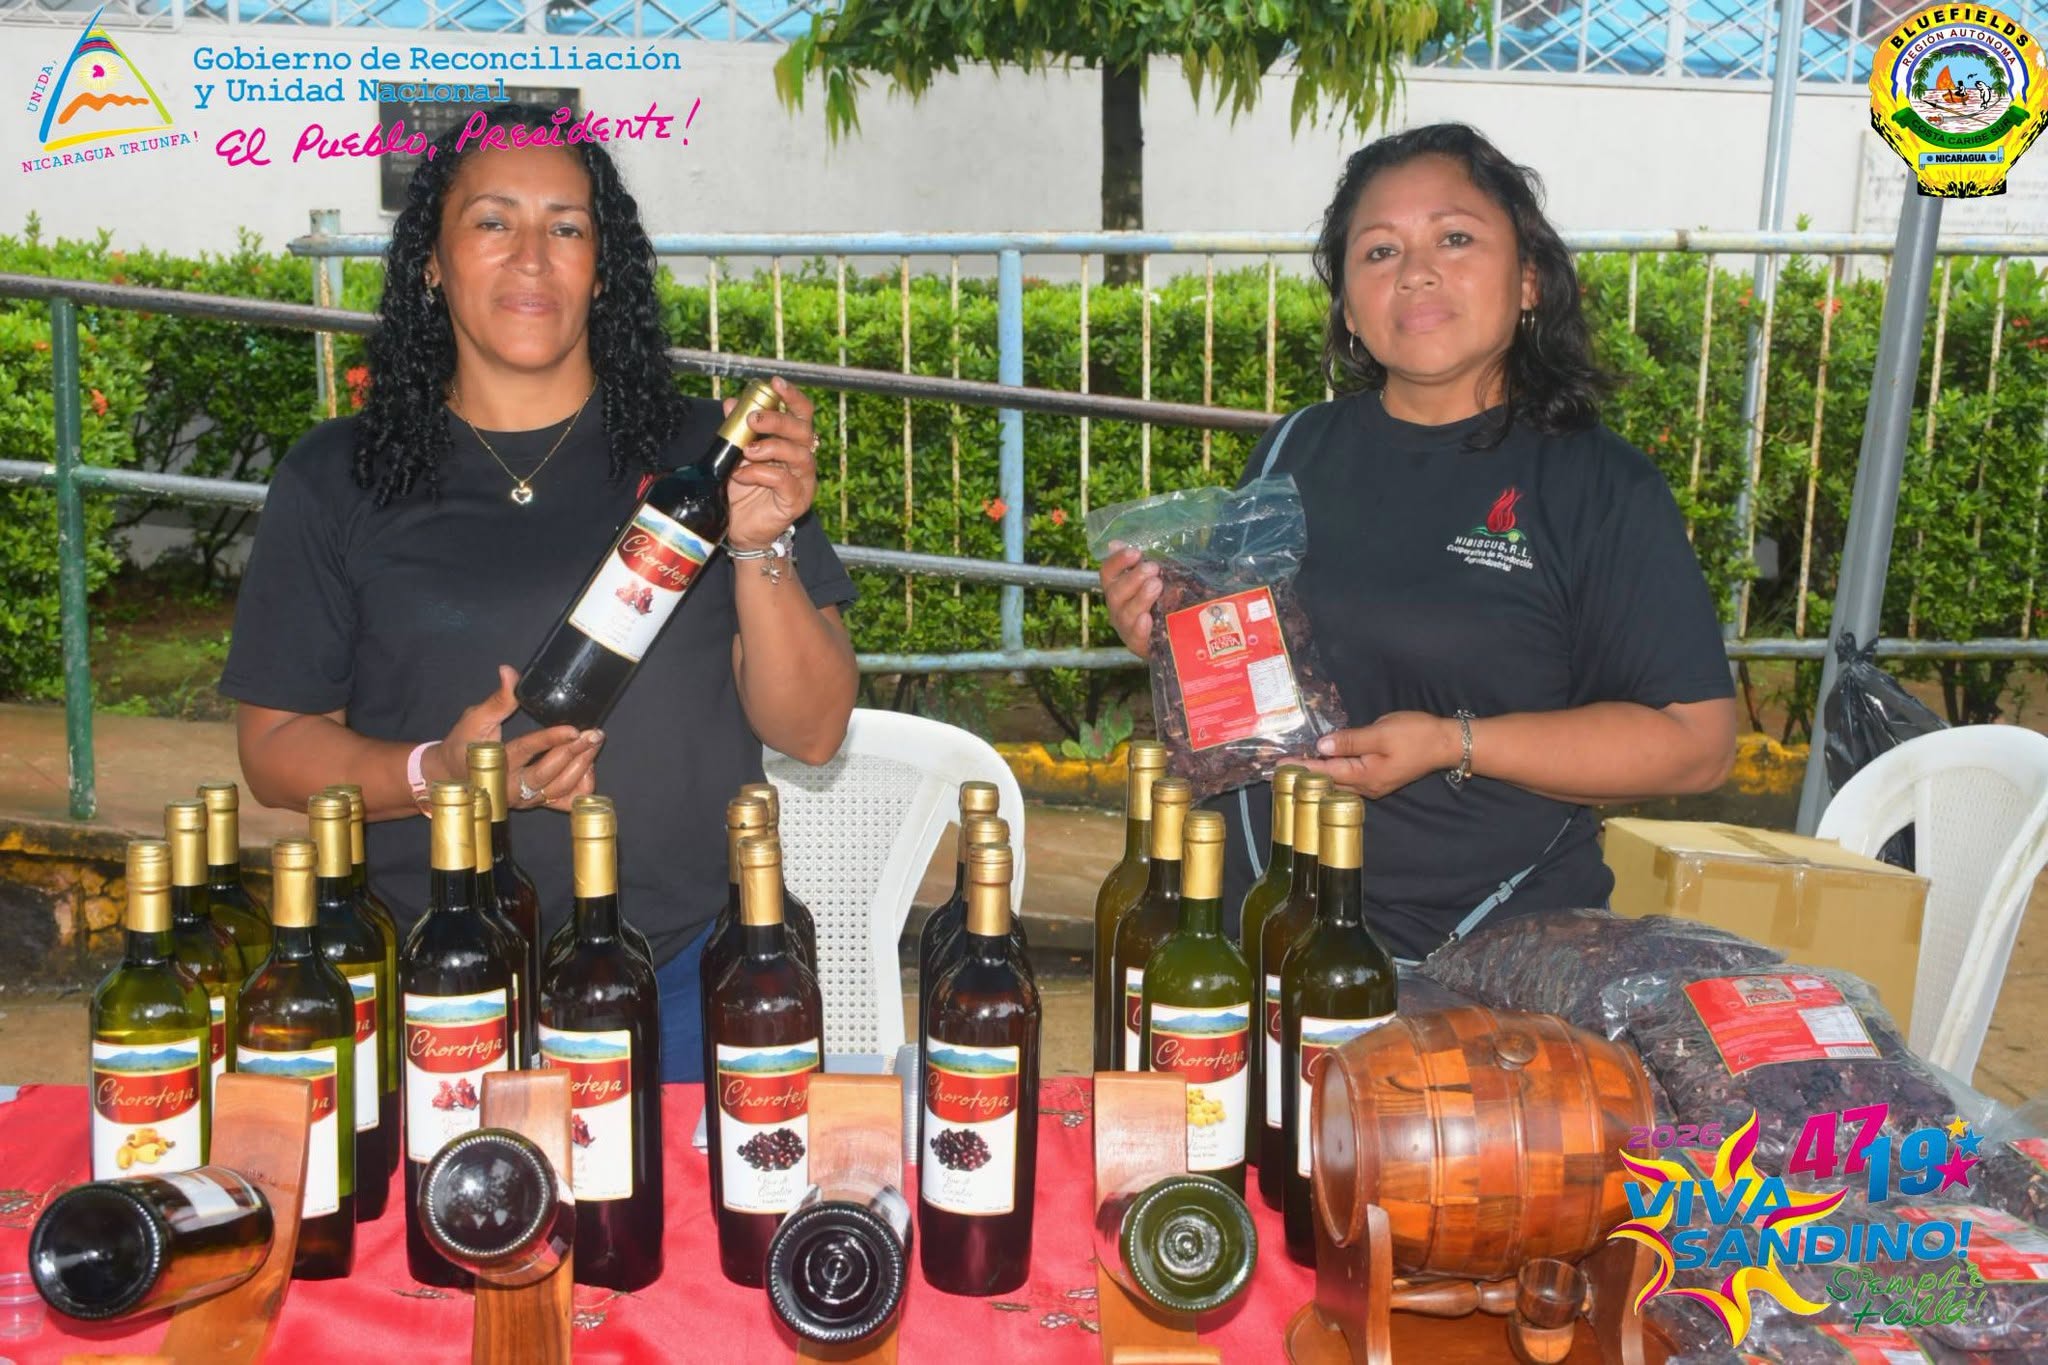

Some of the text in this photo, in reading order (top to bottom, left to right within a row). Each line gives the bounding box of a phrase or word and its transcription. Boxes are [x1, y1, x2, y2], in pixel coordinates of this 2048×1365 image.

[622, 534, 690, 586] Chorotega
[410, 1029, 503, 1060] Chorotega
[1156, 1039, 1245, 1072] Chorotega
[98, 1078, 194, 1110] Chorotega
[724, 1080, 808, 1110] Choroteg
[927, 1072, 1010, 1115] Chorotega
